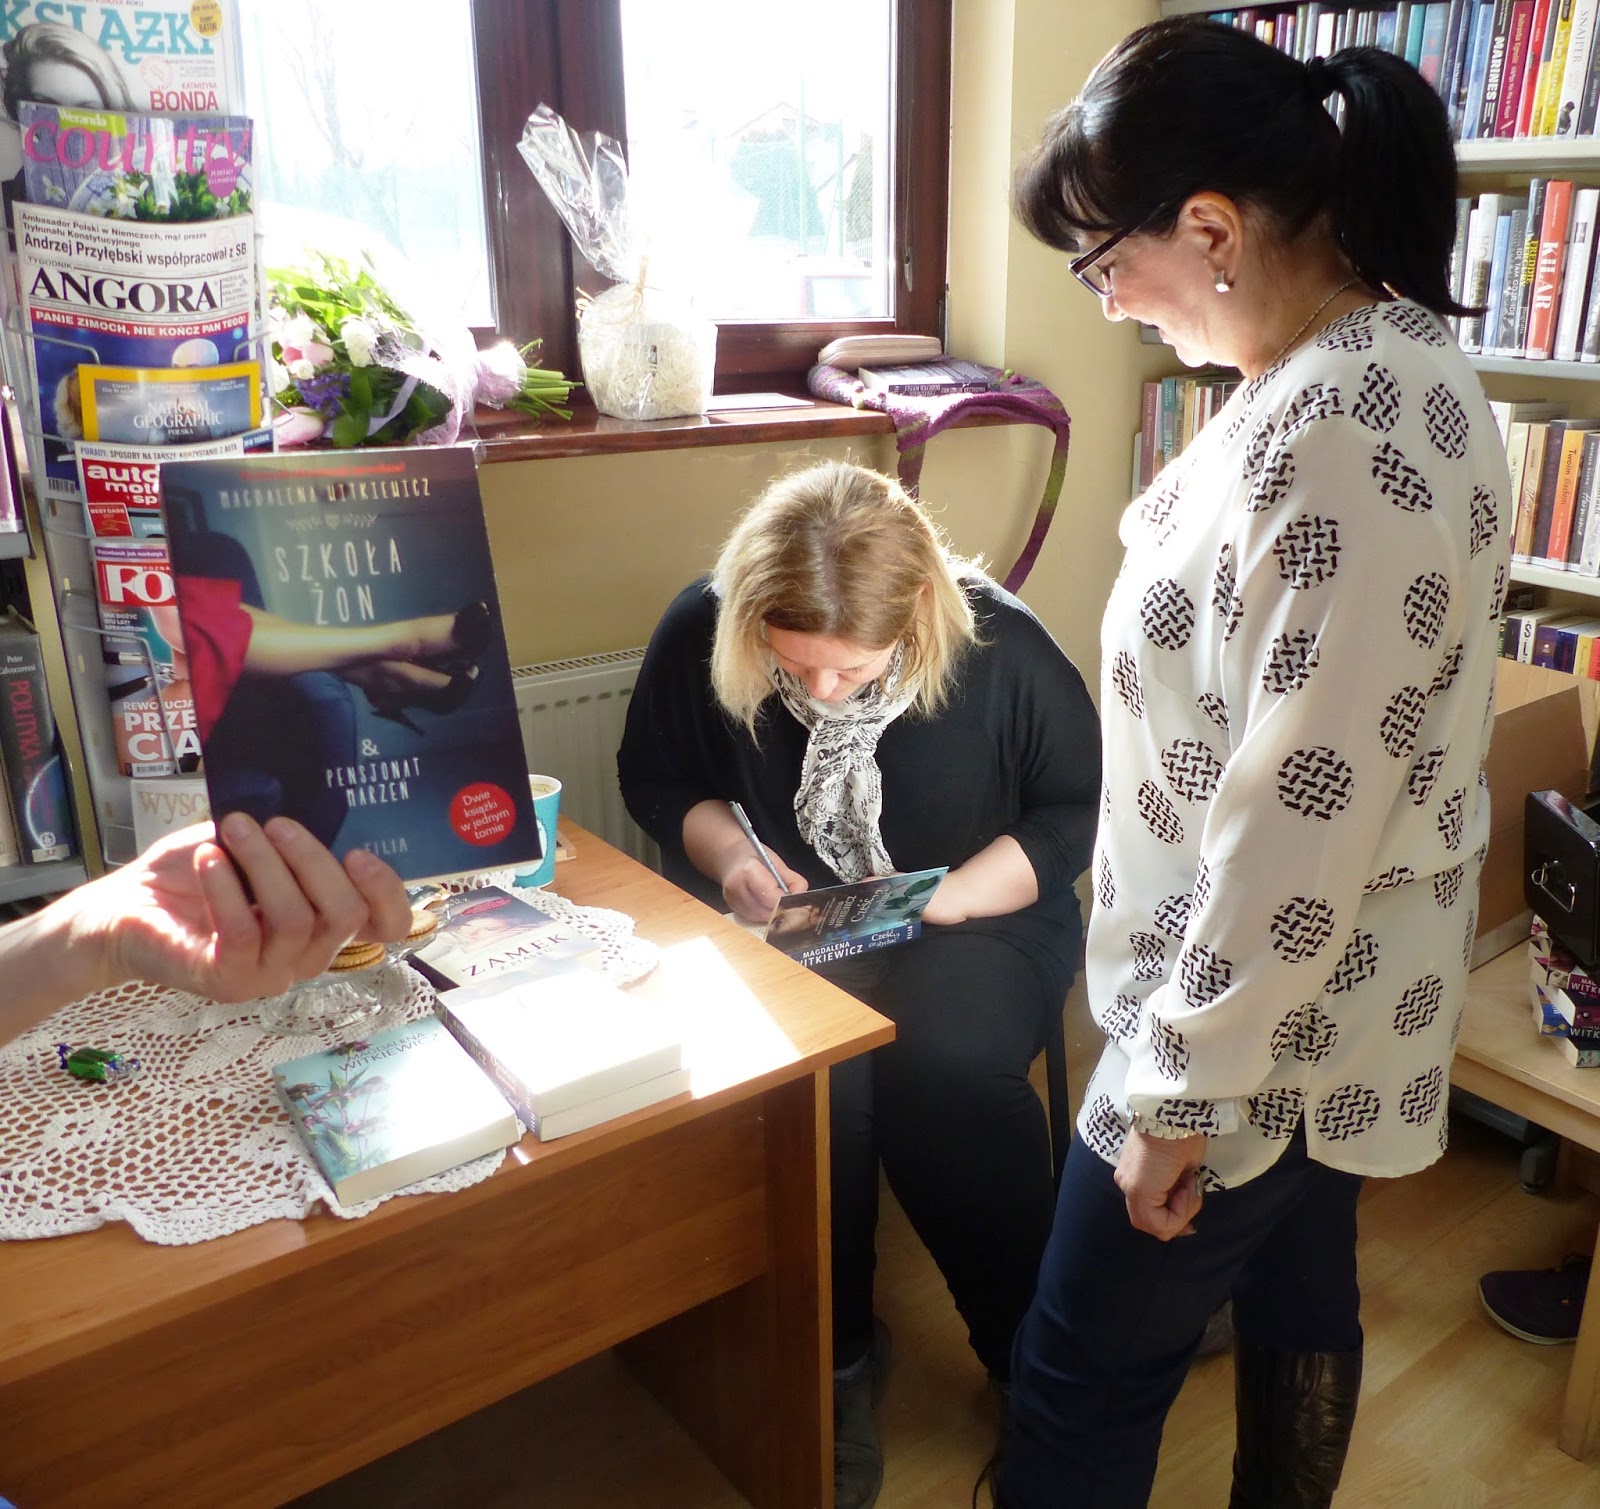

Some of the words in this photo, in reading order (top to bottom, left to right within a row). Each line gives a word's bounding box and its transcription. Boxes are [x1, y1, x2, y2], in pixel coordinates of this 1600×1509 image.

[1572, 10, 1590, 64] SNAJPER
[1485, 36, 1506, 101] MARINES
[149, 90, 219, 112] BONDA
[22, 213, 70, 228] Ambasador
[73, 221, 100, 233] Polski
[101, 227, 109, 235] w
[111, 228, 163, 241] Niemczech,
[23, 222, 65, 237] Trybunału
[67, 230, 141, 248] Konstytucyjnego
[24, 233, 72, 257] Andrzej
[76, 242, 143, 265] Przyłębski
[147, 247, 227, 268] współpracował
[235, 242, 247, 257] SB
[28, 256, 73, 270] TYGODNIK
[1534, 242, 1559, 310] KILAR
[30, 267, 219, 314] ANGORA
[36, 310, 74, 326] PANIE
[77, 317, 131, 336] ZIMOCH,
[133, 325, 156, 337] NIE
[159, 321, 200, 337] KOŃCZ
[202, 323, 222, 335] PAN
[222, 316, 247, 331] TEGO!
[133, 410, 224, 429] GEOGRAPHIC
[147, 400, 209, 415] NATIONAL
[110, 450, 141, 460] SPOSOBY
[143, 452, 152, 460] NA
[1564, 448, 1577, 475] Twoim
[219, 487, 318, 510] MAGDALENA
[326, 477, 431, 503] WITKIEWICZ
[274, 537, 402, 583] SZKOŁA
[311, 582, 376, 626] ŻON
[123, 700, 195, 710] REWOUCJA
[361, 738, 380, 756] &
[326, 757, 421, 789] PENSJONAT
[345, 775, 410, 808] MARZEŃ
[462, 789, 491, 807] Dwie
[460, 823, 472, 833] w
[472, 808, 510, 830] jednym
[463, 799, 499, 819] książki
[474, 822, 505, 840] tomie
[462, 933, 569, 977] ZAMEK
[802, 941, 851, 959] MAGDALENA
[338, 1032, 439, 1073] WITKIEWICZ
[347, 1031, 426, 1062] MAGDALENA
